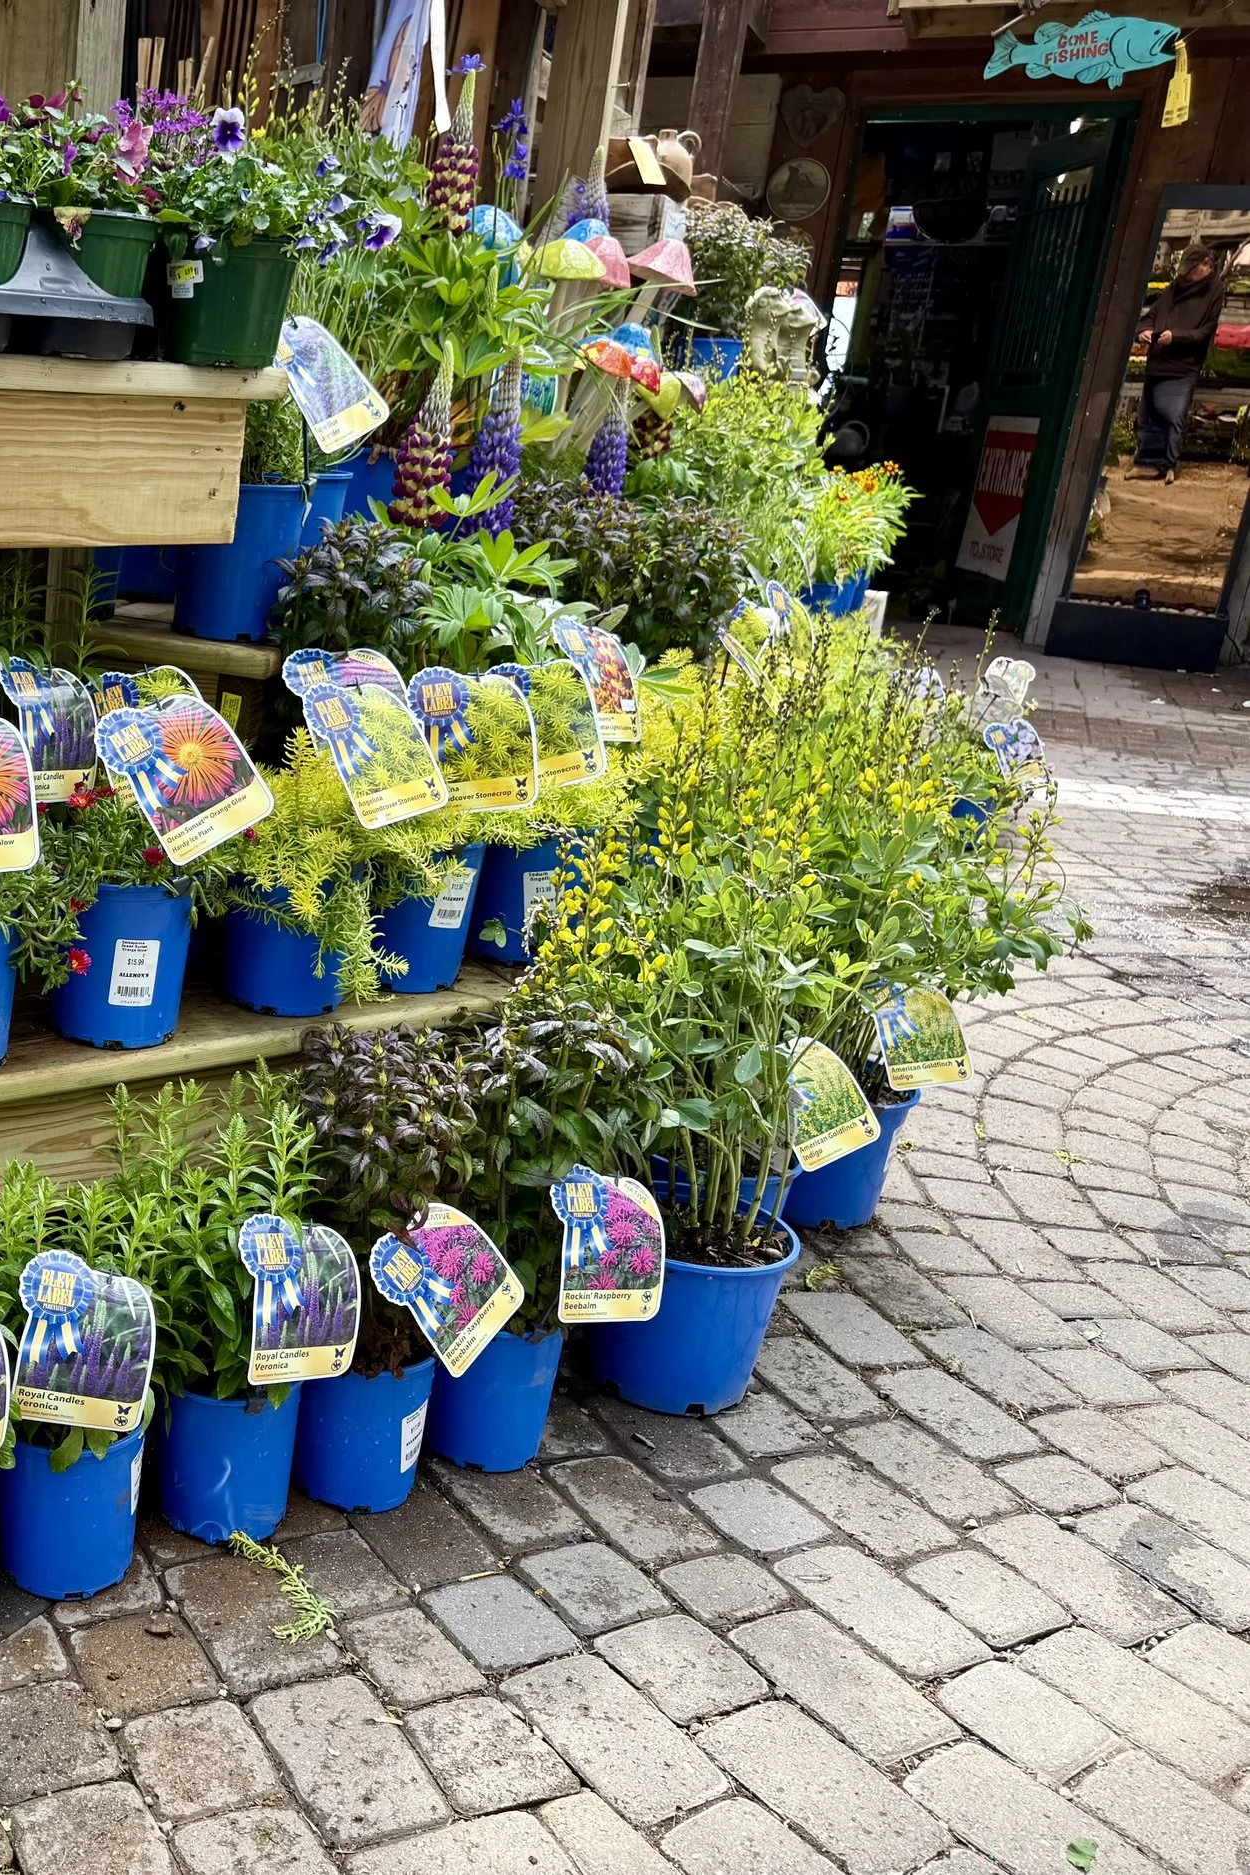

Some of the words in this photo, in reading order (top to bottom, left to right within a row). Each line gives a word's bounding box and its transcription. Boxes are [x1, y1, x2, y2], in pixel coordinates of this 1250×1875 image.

[1058, 30, 1099, 49] GONE
[1044, 43, 1110, 65] FISHING
[978, 448, 1032, 497] ENTRANCE
[297, 660, 325, 676] BLEW
[300, 672, 331, 687] LABEL
[422, 682, 452, 698] BLEW
[315, 697, 342, 717] BLEW
[423, 696, 456, 712] LABEL
[320, 710, 351, 728] LABEL
[109, 723, 141, 747] BLEW
[117, 735, 151, 761] LABEL
[43, 773, 64, 781] Candles
[546, 764, 581, 777] Stonecrop
[358, 796, 383, 808] Angelina
[476, 790, 511, 799] Stonecrop
[362, 800, 397, 817] Groundcover
[398, 792, 427, 806] Stonecrop
[167, 829, 185, 844] Ocean
[209, 802, 232, 819] Orange
[232, 795, 247, 806] Glow
[172, 841, 190, 854] Hardy
[190, 835, 199, 843] Ice
[199, 826, 214, 838] Plant
[892, 1065, 921, 1073] American
[922, 1060, 953, 1069] Goldfinch
[893, 1074, 913, 1082] Indigo
[800, 1131, 828, 1154] American
[828, 1121, 858, 1140] Goldfinch
[803, 1147, 822, 1162] Indigo
[566, 1183, 593, 1197] BLEW
[567, 1197, 598, 1212] LABEL
[255, 1233, 284, 1248] BLEW
[256, 1248, 289, 1264] LABEL
[384, 1246, 411, 1278] BLEW
[42, 1269, 78, 1287] BLEW
[393, 1261, 423, 1292] LABEL
[37, 1285, 75, 1306] LABEL
[565, 1292, 592, 1300] Rockin'
[594, 1292, 631, 1300] Raspberry
[446, 1332, 467, 1359] Rockin'
[467, 1299, 496, 1335] Raspberry
[256, 1352, 278, 1361] Royal
[280, 1350, 309, 1359] Candles
[450, 1336, 476, 1367] Beebalm
[255, 1362, 288, 1371] Veronica
[17, 1398, 59, 1411] Veronica
[18, 1388, 45, 1400] Royal
[47, 1393, 85, 1406] Candles
